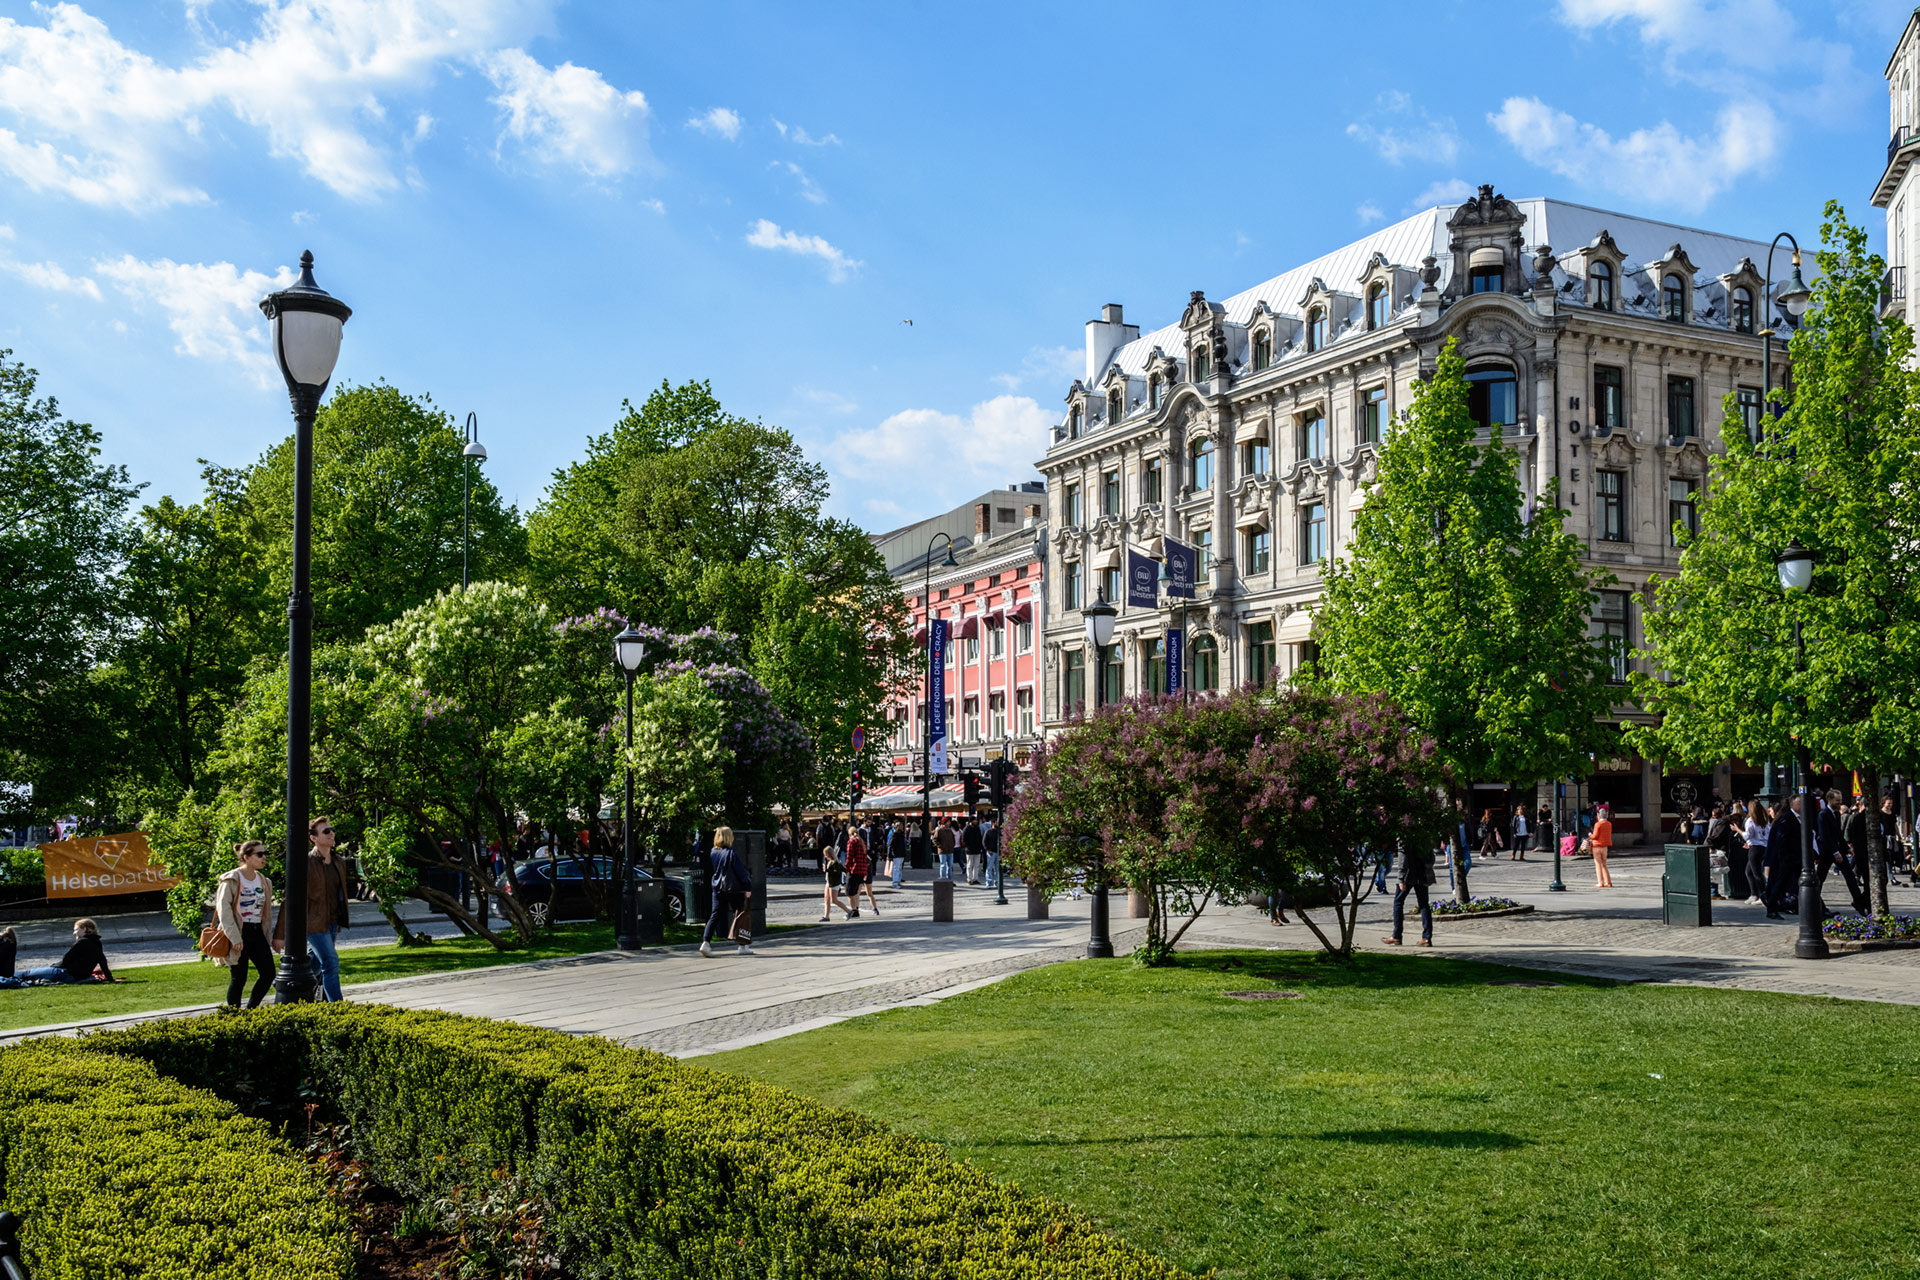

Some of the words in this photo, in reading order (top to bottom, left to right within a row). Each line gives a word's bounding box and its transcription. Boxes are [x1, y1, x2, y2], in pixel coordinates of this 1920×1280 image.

[1569, 396, 1581, 506] HOTEL
[1137, 571, 1149, 580] BW
[1130, 590, 1156, 599] Western
[1136, 584, 1151, 592] Best
[1170, 636, 1178, 663] FORUM
[51, 867, 177, 891] Helsepartie
